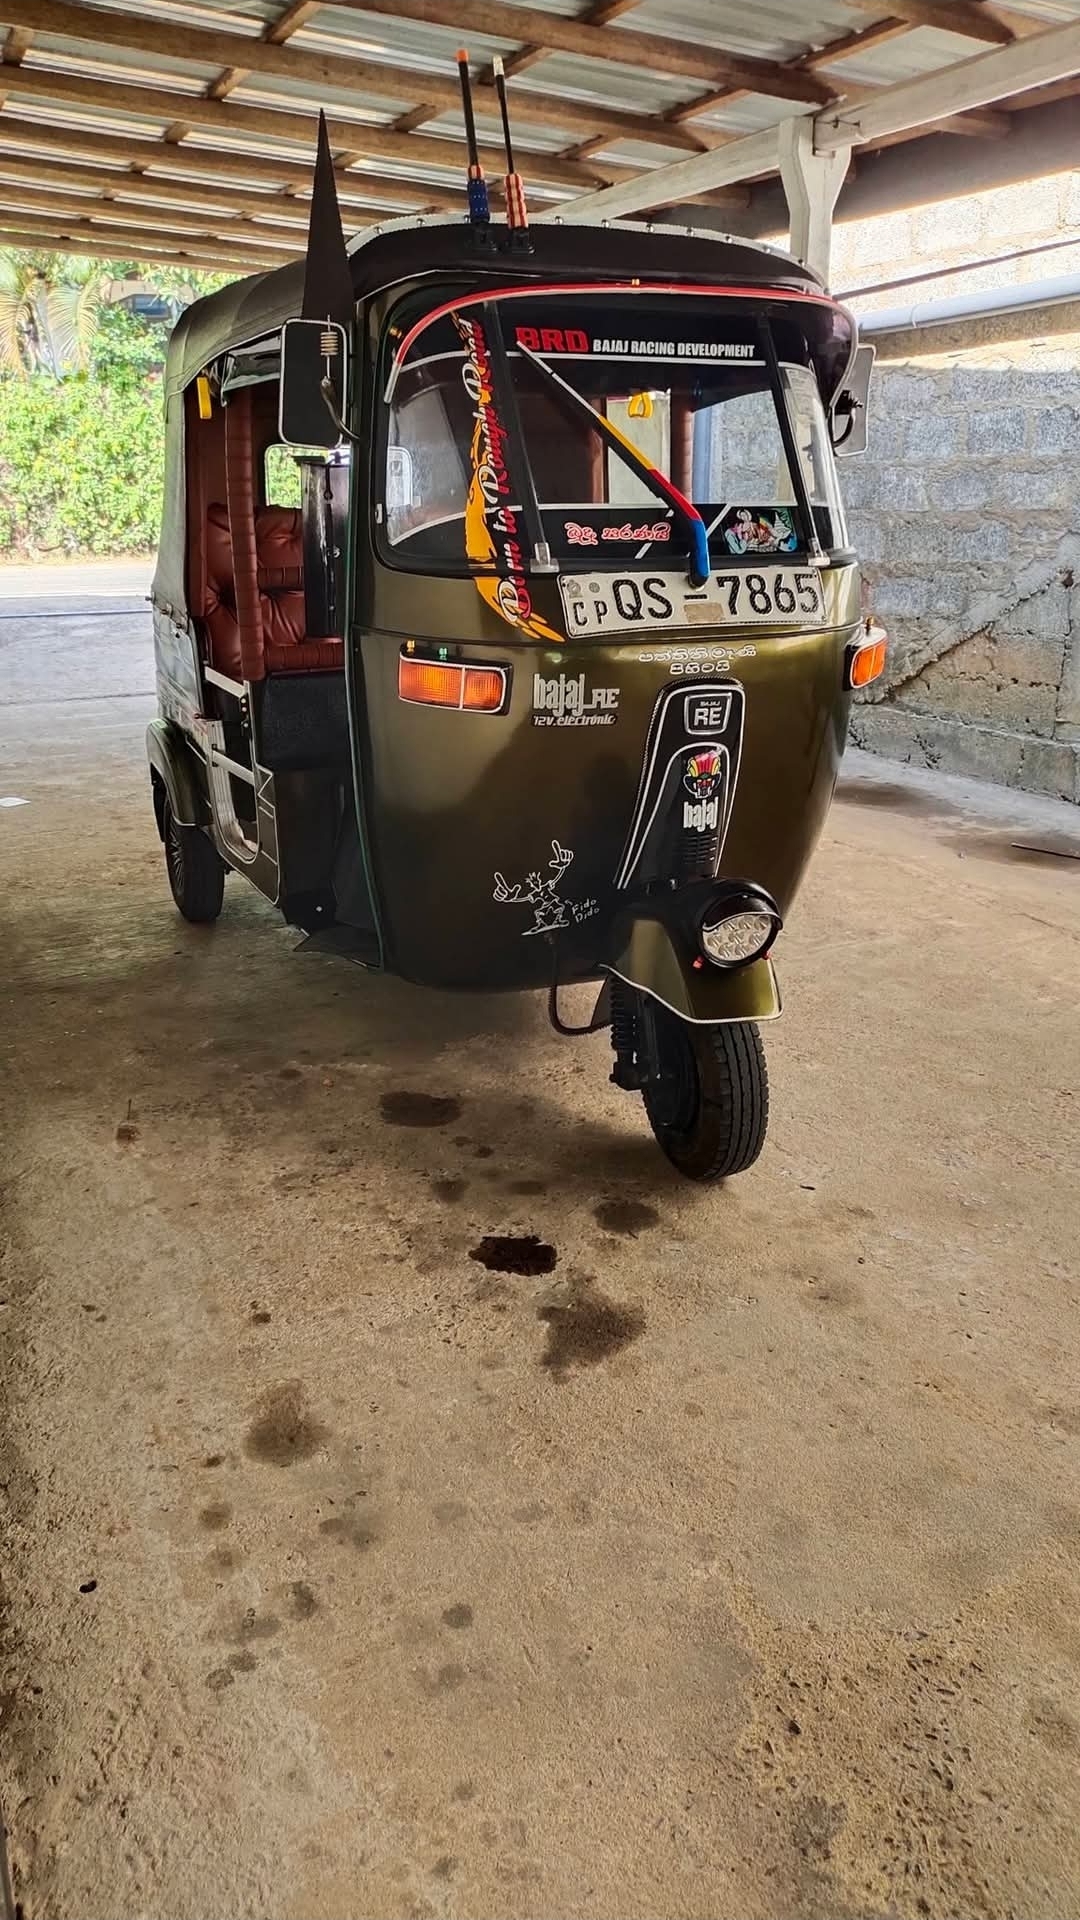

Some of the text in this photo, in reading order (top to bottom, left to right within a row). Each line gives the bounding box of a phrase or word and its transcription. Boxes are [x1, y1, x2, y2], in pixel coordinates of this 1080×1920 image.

[515, 327, 755, 358] BRD BAJAJ RACING DEVELOPMENT
[459, 317, 533, 622] Born to Rough Road
[693, 706, 722, 726] RE
[683, 796, 719, 832] bajaj
[572, 898, 597, 915] Fido
[575, 906, 600, 923] Dido
